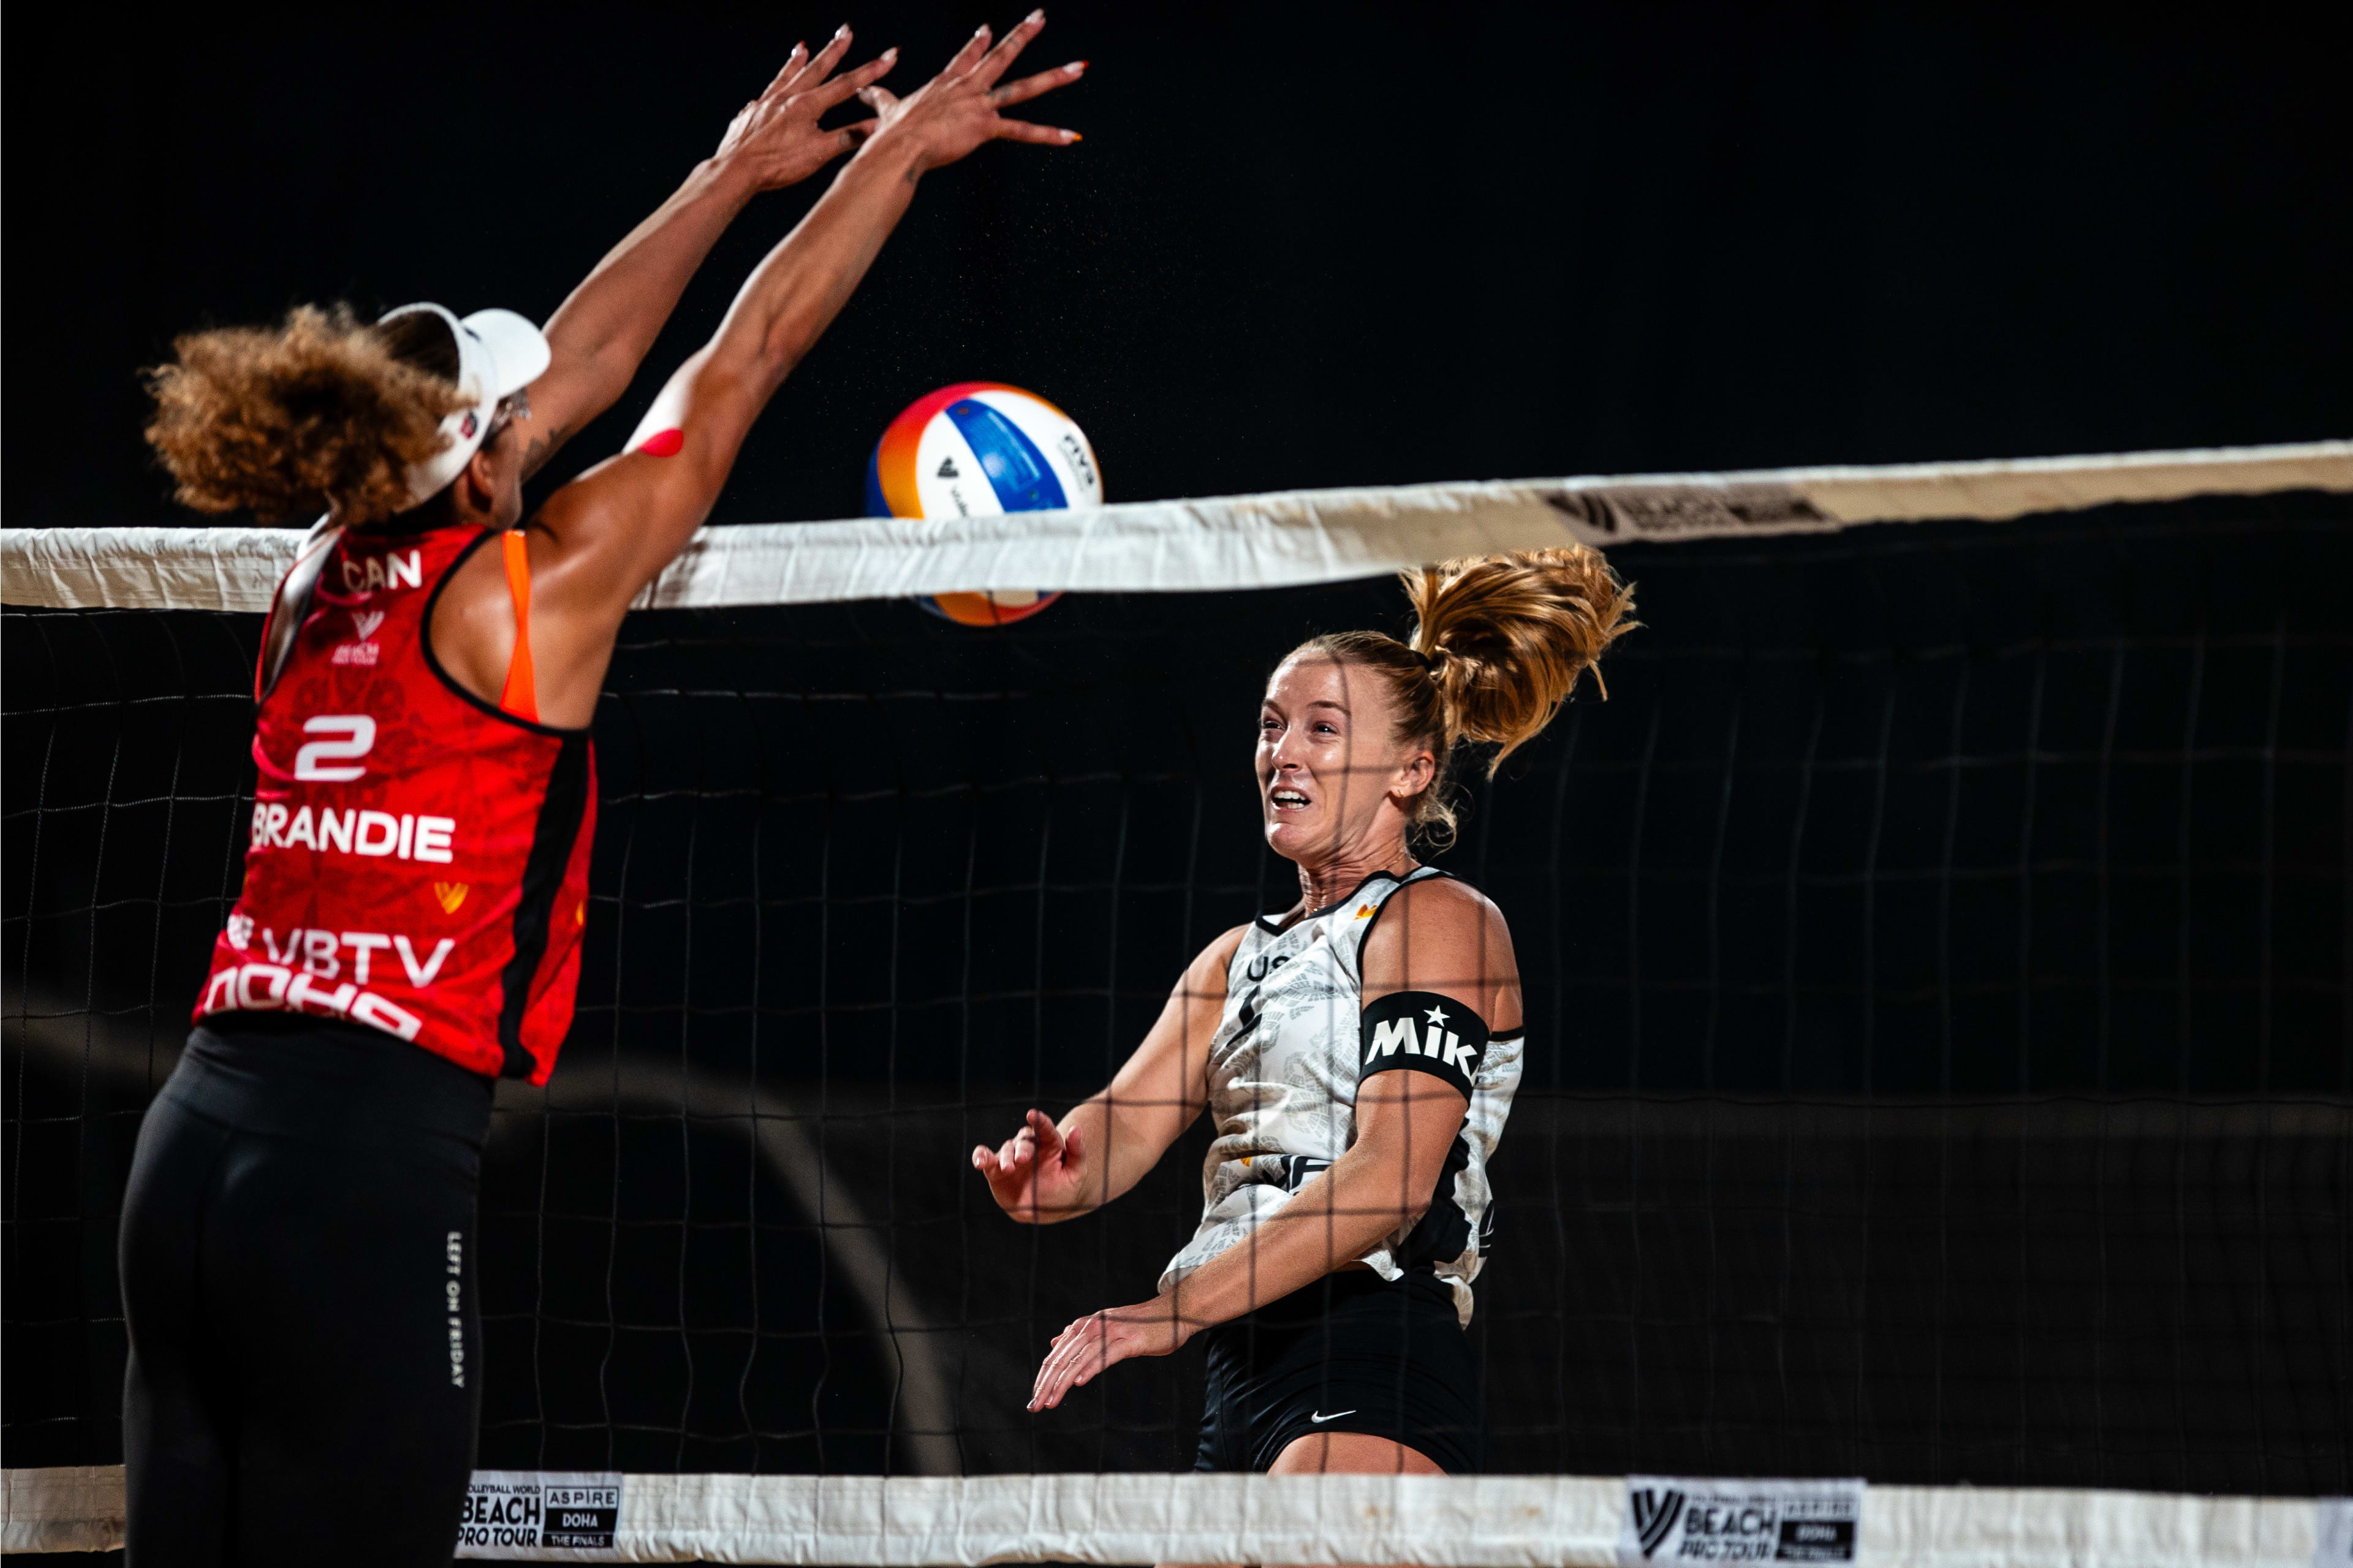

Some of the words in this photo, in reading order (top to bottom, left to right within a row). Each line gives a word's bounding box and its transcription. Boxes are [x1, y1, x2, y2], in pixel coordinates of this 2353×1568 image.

[342, 550, 422, 593] CAN
[294, 714, 376, 782] 2
[251, 802, 456, 864] BRANDIE
[262, 927, 455, 988] VBTV
[446, 1231, 463, 1276] LEFT
[445, 1279, 461, 1312] ON
[447, 1317, 465, 1388] FRIDAY
[467, 1484, 511, 1494] OLLEYBALL
[512, 1485, 541, 1495] WORLD
[550, 1490, 615, 1507] ASPIRE
[461, 1496, 540, 1526] BEACH
[562, 1512, 599, 1528] DOHA
[1686, 1507, 1776, 1536] BEACH
[457, 1526, 489, 1546] PRO
[492, 1528, 537, 1547] TOUR
[551, 1534, 570, 1547] THE
[572, 1535, 605, 1547] FINALS
